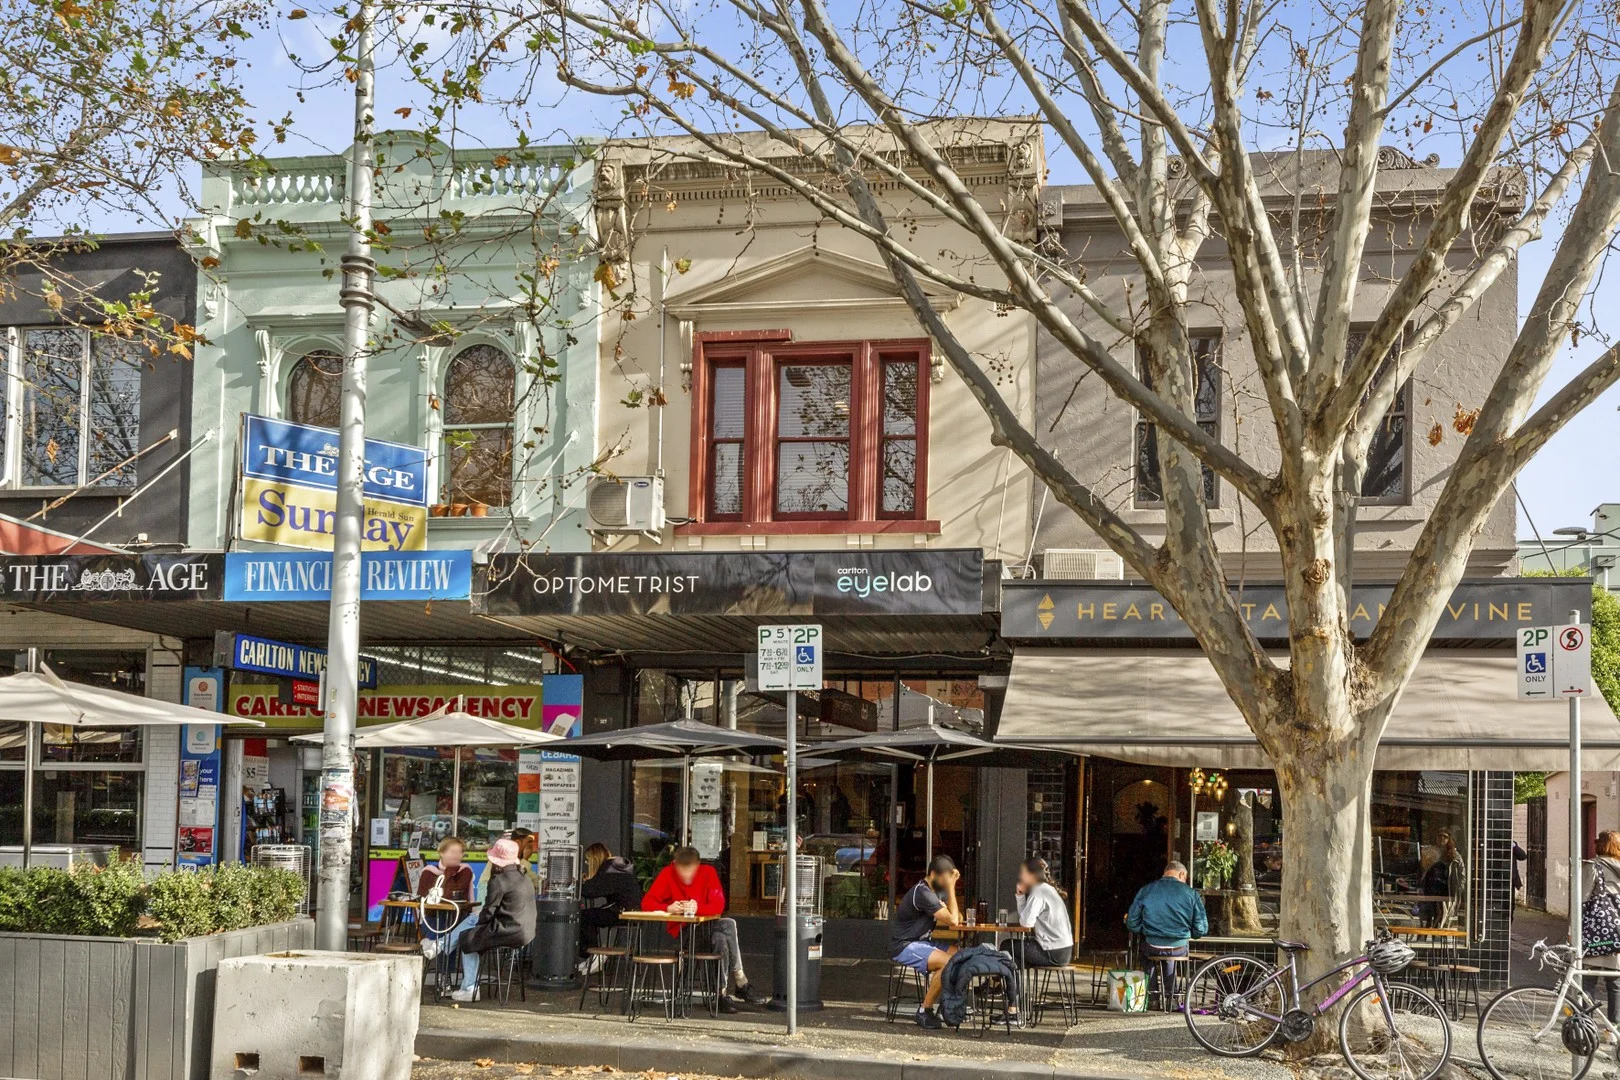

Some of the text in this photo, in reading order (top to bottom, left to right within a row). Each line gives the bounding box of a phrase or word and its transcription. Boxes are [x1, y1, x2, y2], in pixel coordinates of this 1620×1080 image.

[259, 444, 414, 491] THE GE
[257, 489, 414, 551] Sunay
[367, 507, 414, 522] Herald Sun
[9, 562, 208, 592] THE AGE
[244, 560, 332, 592] FINANCI
[366, 559, 454, 591] REVIEW
[837, 567, 868, 575] carlton
[533, 575, 700, 594] OPTOMETRIST
[836, 570, 932, 598] eyelab
[1077, 602, 1183, 621] HEAR
[1446, 602, 1533, 621] VINE
[760, 628, 785, 644] P 5
[794, 628, 819, 643] 2P
[1523, 629, 1548, 647] 2P
[240, 639, 371, 683] CARLTON NEWSCY
[1525, 675, 1547, 683] ONLY
[235, 694, 536, 719] CARL NEWSAGENCY
